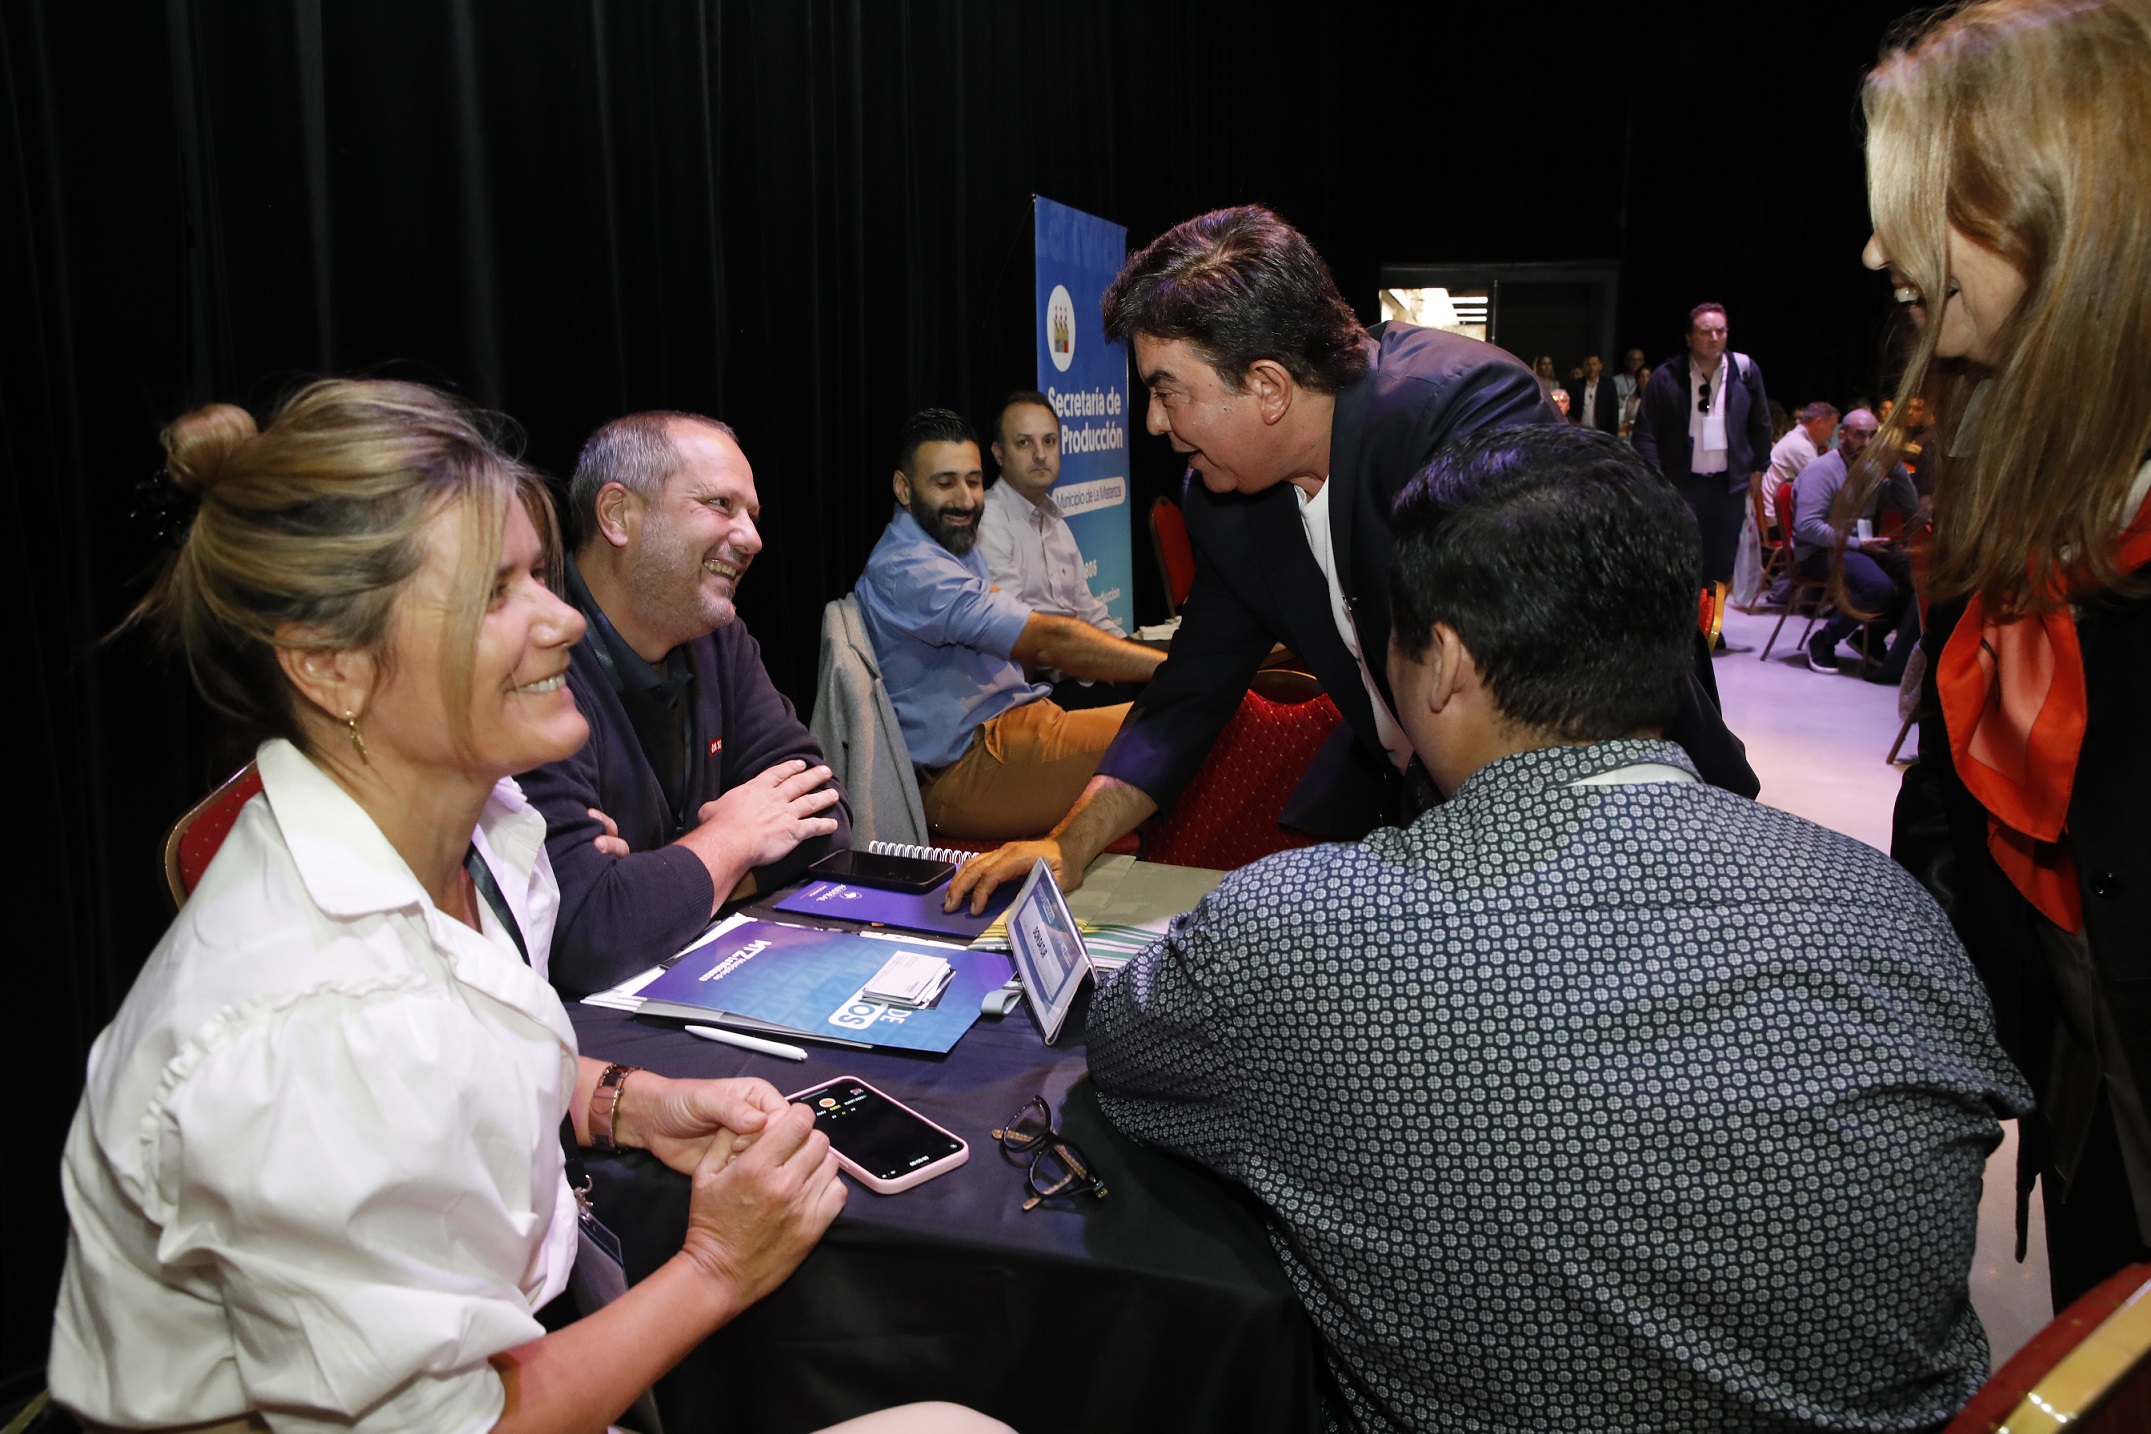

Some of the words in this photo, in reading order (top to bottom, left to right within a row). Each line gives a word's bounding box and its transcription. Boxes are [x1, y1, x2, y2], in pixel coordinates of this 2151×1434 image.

[1048, 386, 1104, 417] Secretaría
[1107, 386, 1121, 415] de
[1061, 420, 1123, 455] Producción
[1056, 490, 1084, 509] Municipio
[1085, 487, 1093, 504] de
[880, 1008, 912, 1024] DE
